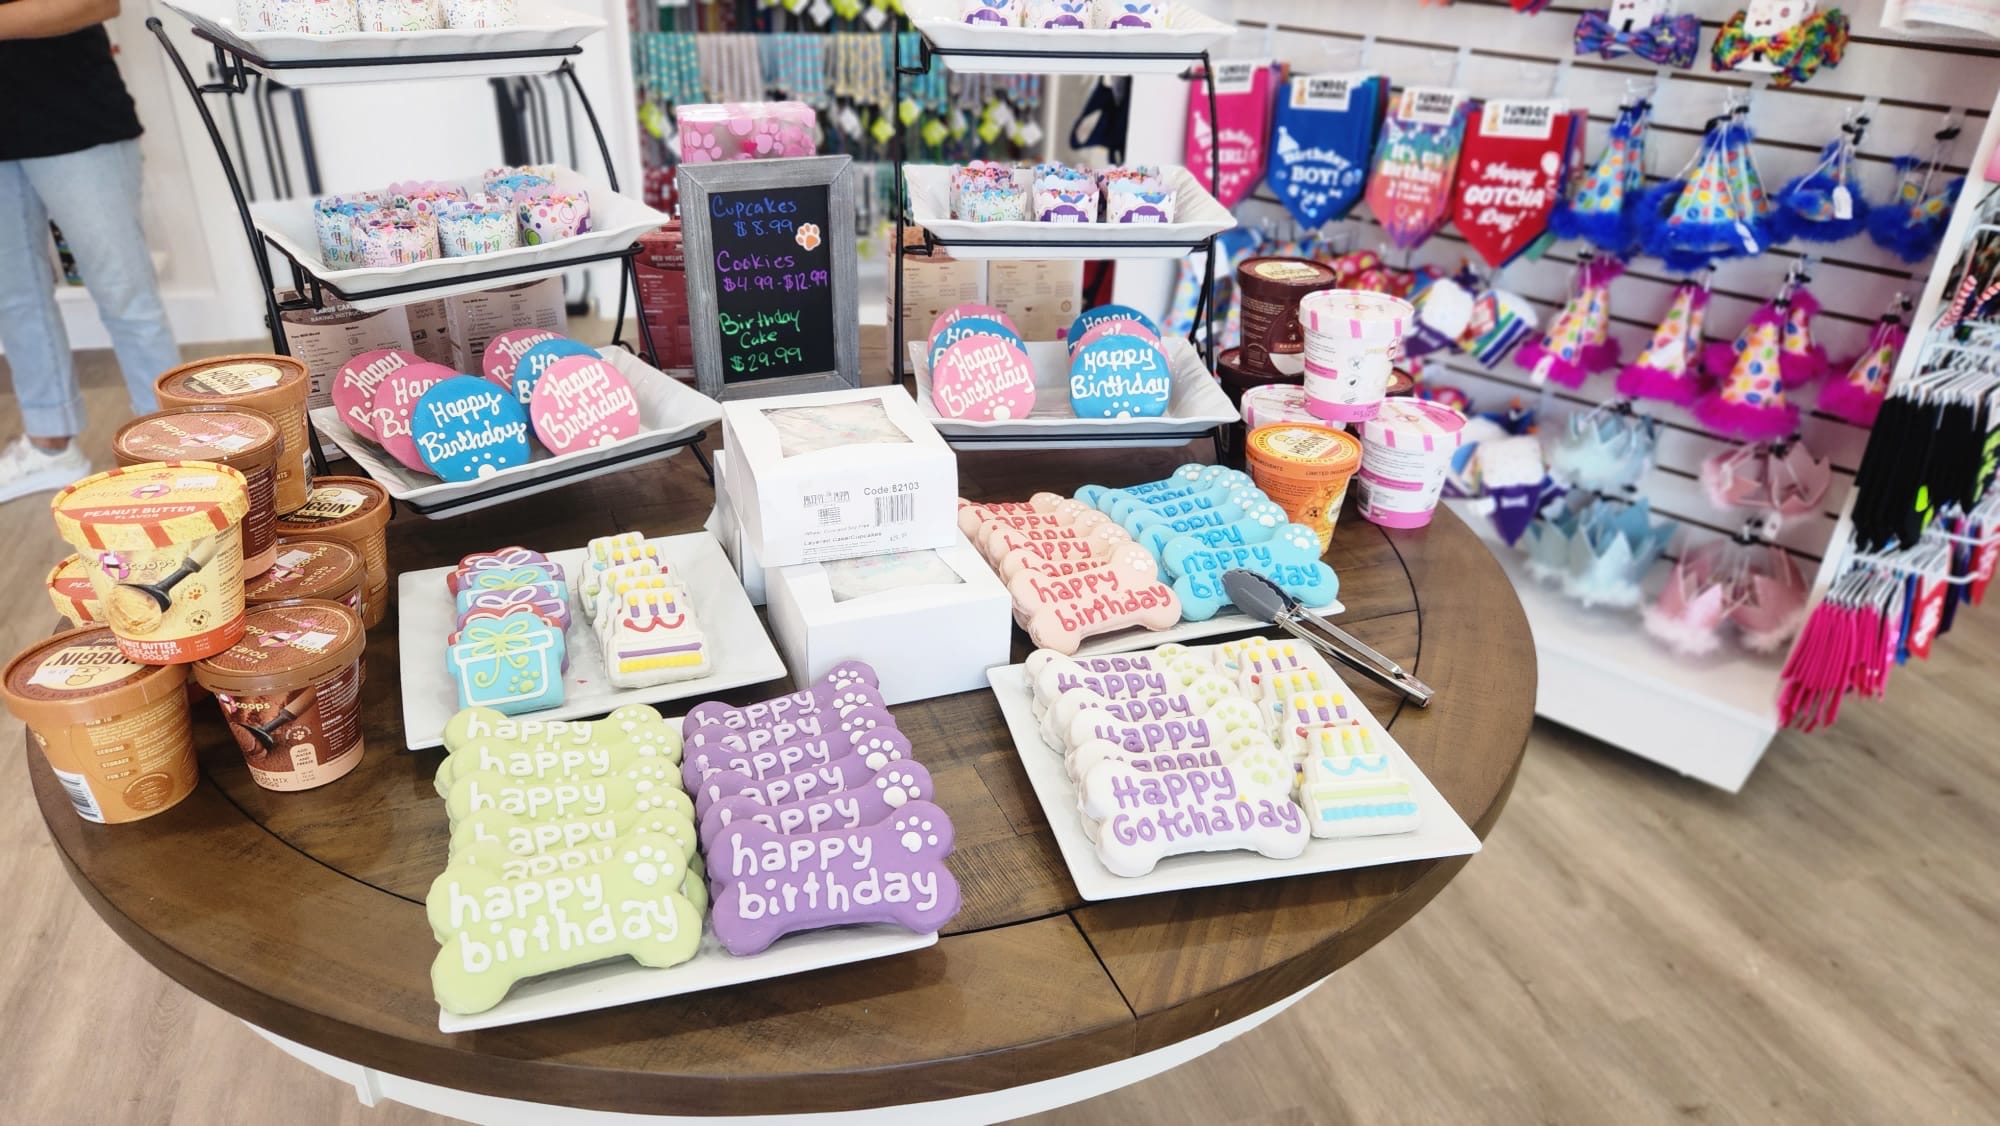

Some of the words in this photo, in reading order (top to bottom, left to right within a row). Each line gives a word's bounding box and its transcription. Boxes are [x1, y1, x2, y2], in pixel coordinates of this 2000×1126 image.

[712, 195, 797, 218] Cupcakes
[1463, 184, 1546, 210] GOTCHA
[733, 219, 794, 237] $8.99
[716, 250, 796, 273] Cookies
[718, 310, 801, 336] Birthday
[740, 330, 778, 349] Cake
[729, 347, 802, 373] $29.99
[947, 341, 1014, 381] Happy
[1084, 348, 1157, 374] Happy
[543, 362, 610, 410] Happy
[940, 363, 1035, 417] Birthday
[1070, 372, 1170, 402] Birthday
[429, 391, 502, 428] Happy
[540, 385, 639, 449] Birthday
[418, 420, 528, 463] Birthday
[83, 507, 138, 519] PEANUT
[141, 504, 197, 516] BUTTER
[1030, 569, 1119, 604] happy
[1188, 563, 1322, 599] biday
[1055, 584, 1172, 632] birthday
[231, 645, 269, 660] carob
[695, 690, 816, 728] happy
[466, 711, 593, 745] happy
[479, 746, 610, 779] happy
[468, 781, 607, 818] happy
[1112, 766, 1237, 810] Happy
[731, 832, 873, 877] happy
[449, 872, 604, 928] happy
[737, 867, 939, 920] birthday
[459, 895, 679, 973] birthday
